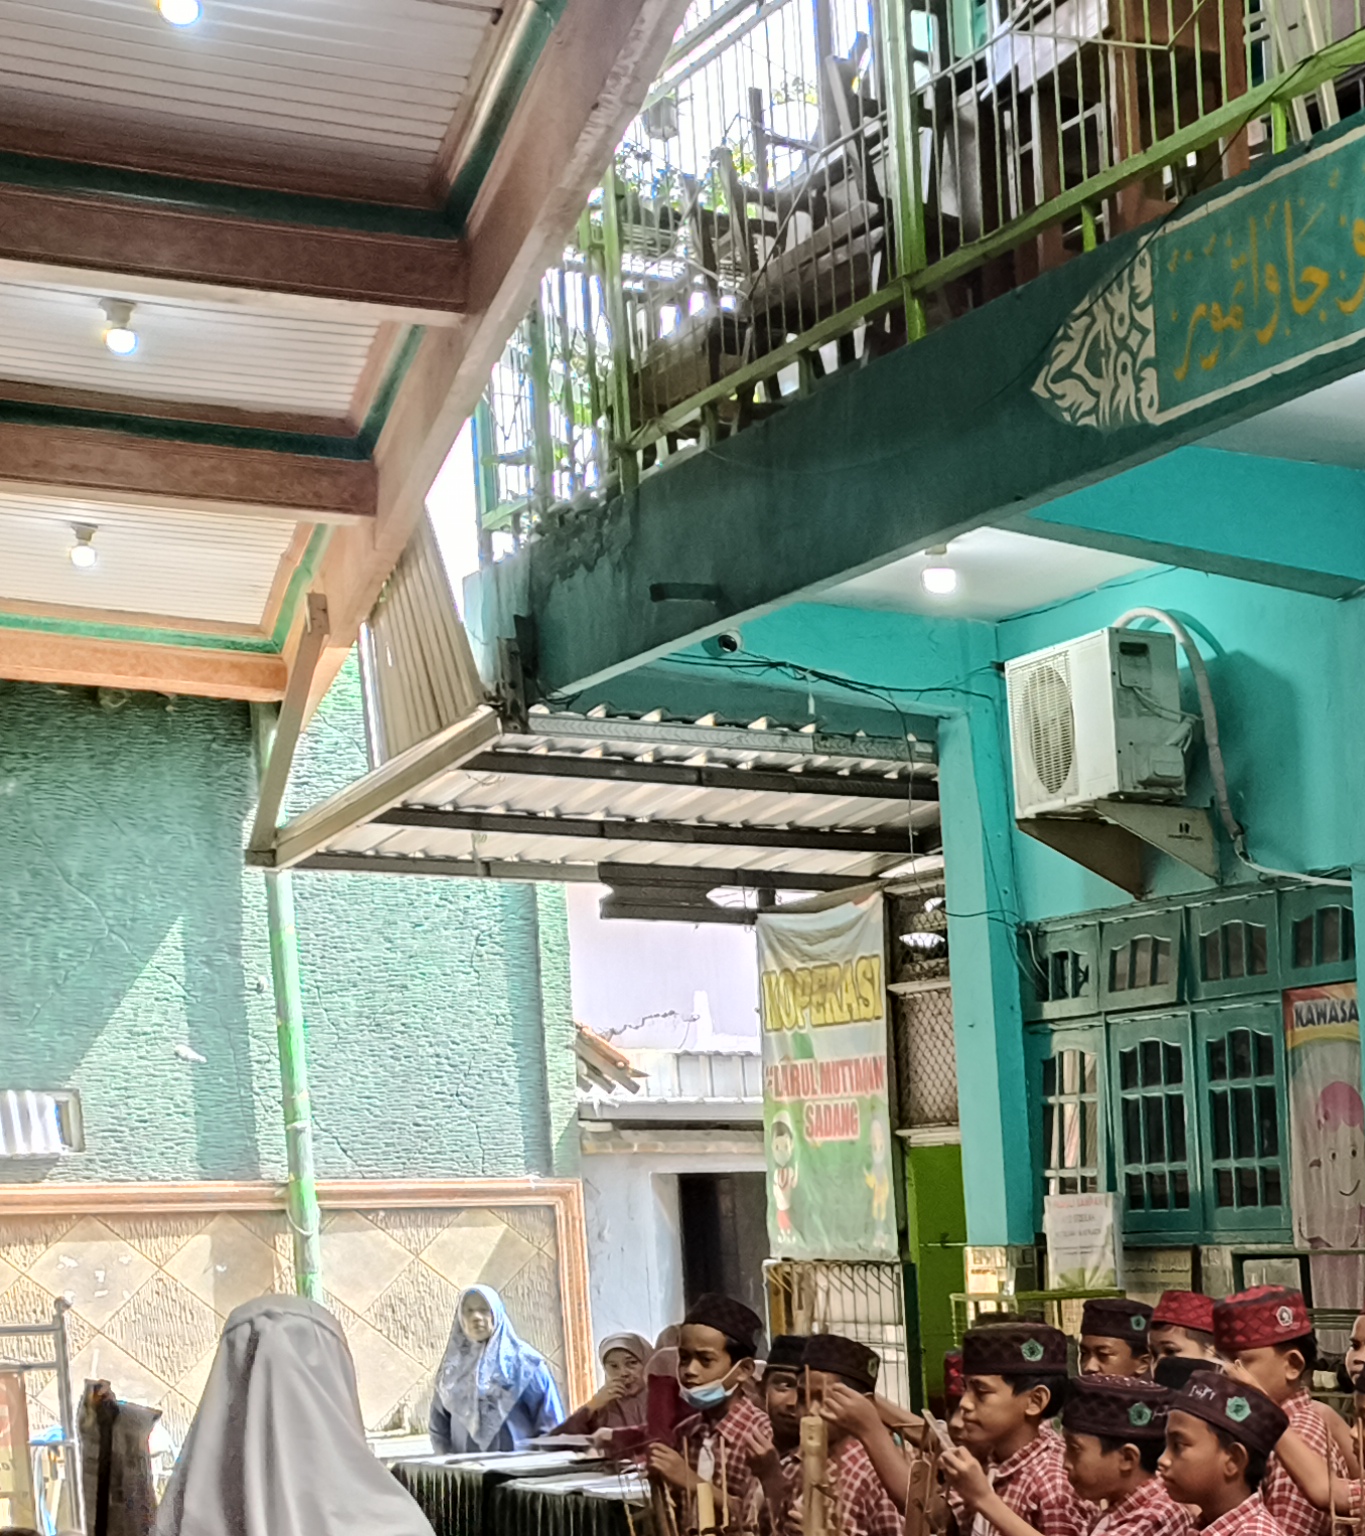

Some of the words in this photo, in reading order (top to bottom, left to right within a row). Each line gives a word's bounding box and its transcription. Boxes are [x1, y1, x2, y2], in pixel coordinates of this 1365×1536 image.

[762, 955, 883, 1033] KOPERASI
[1294, 1000, 1359, 1028] KAWASA
[804, 1100, 860, 1139] SADANG
